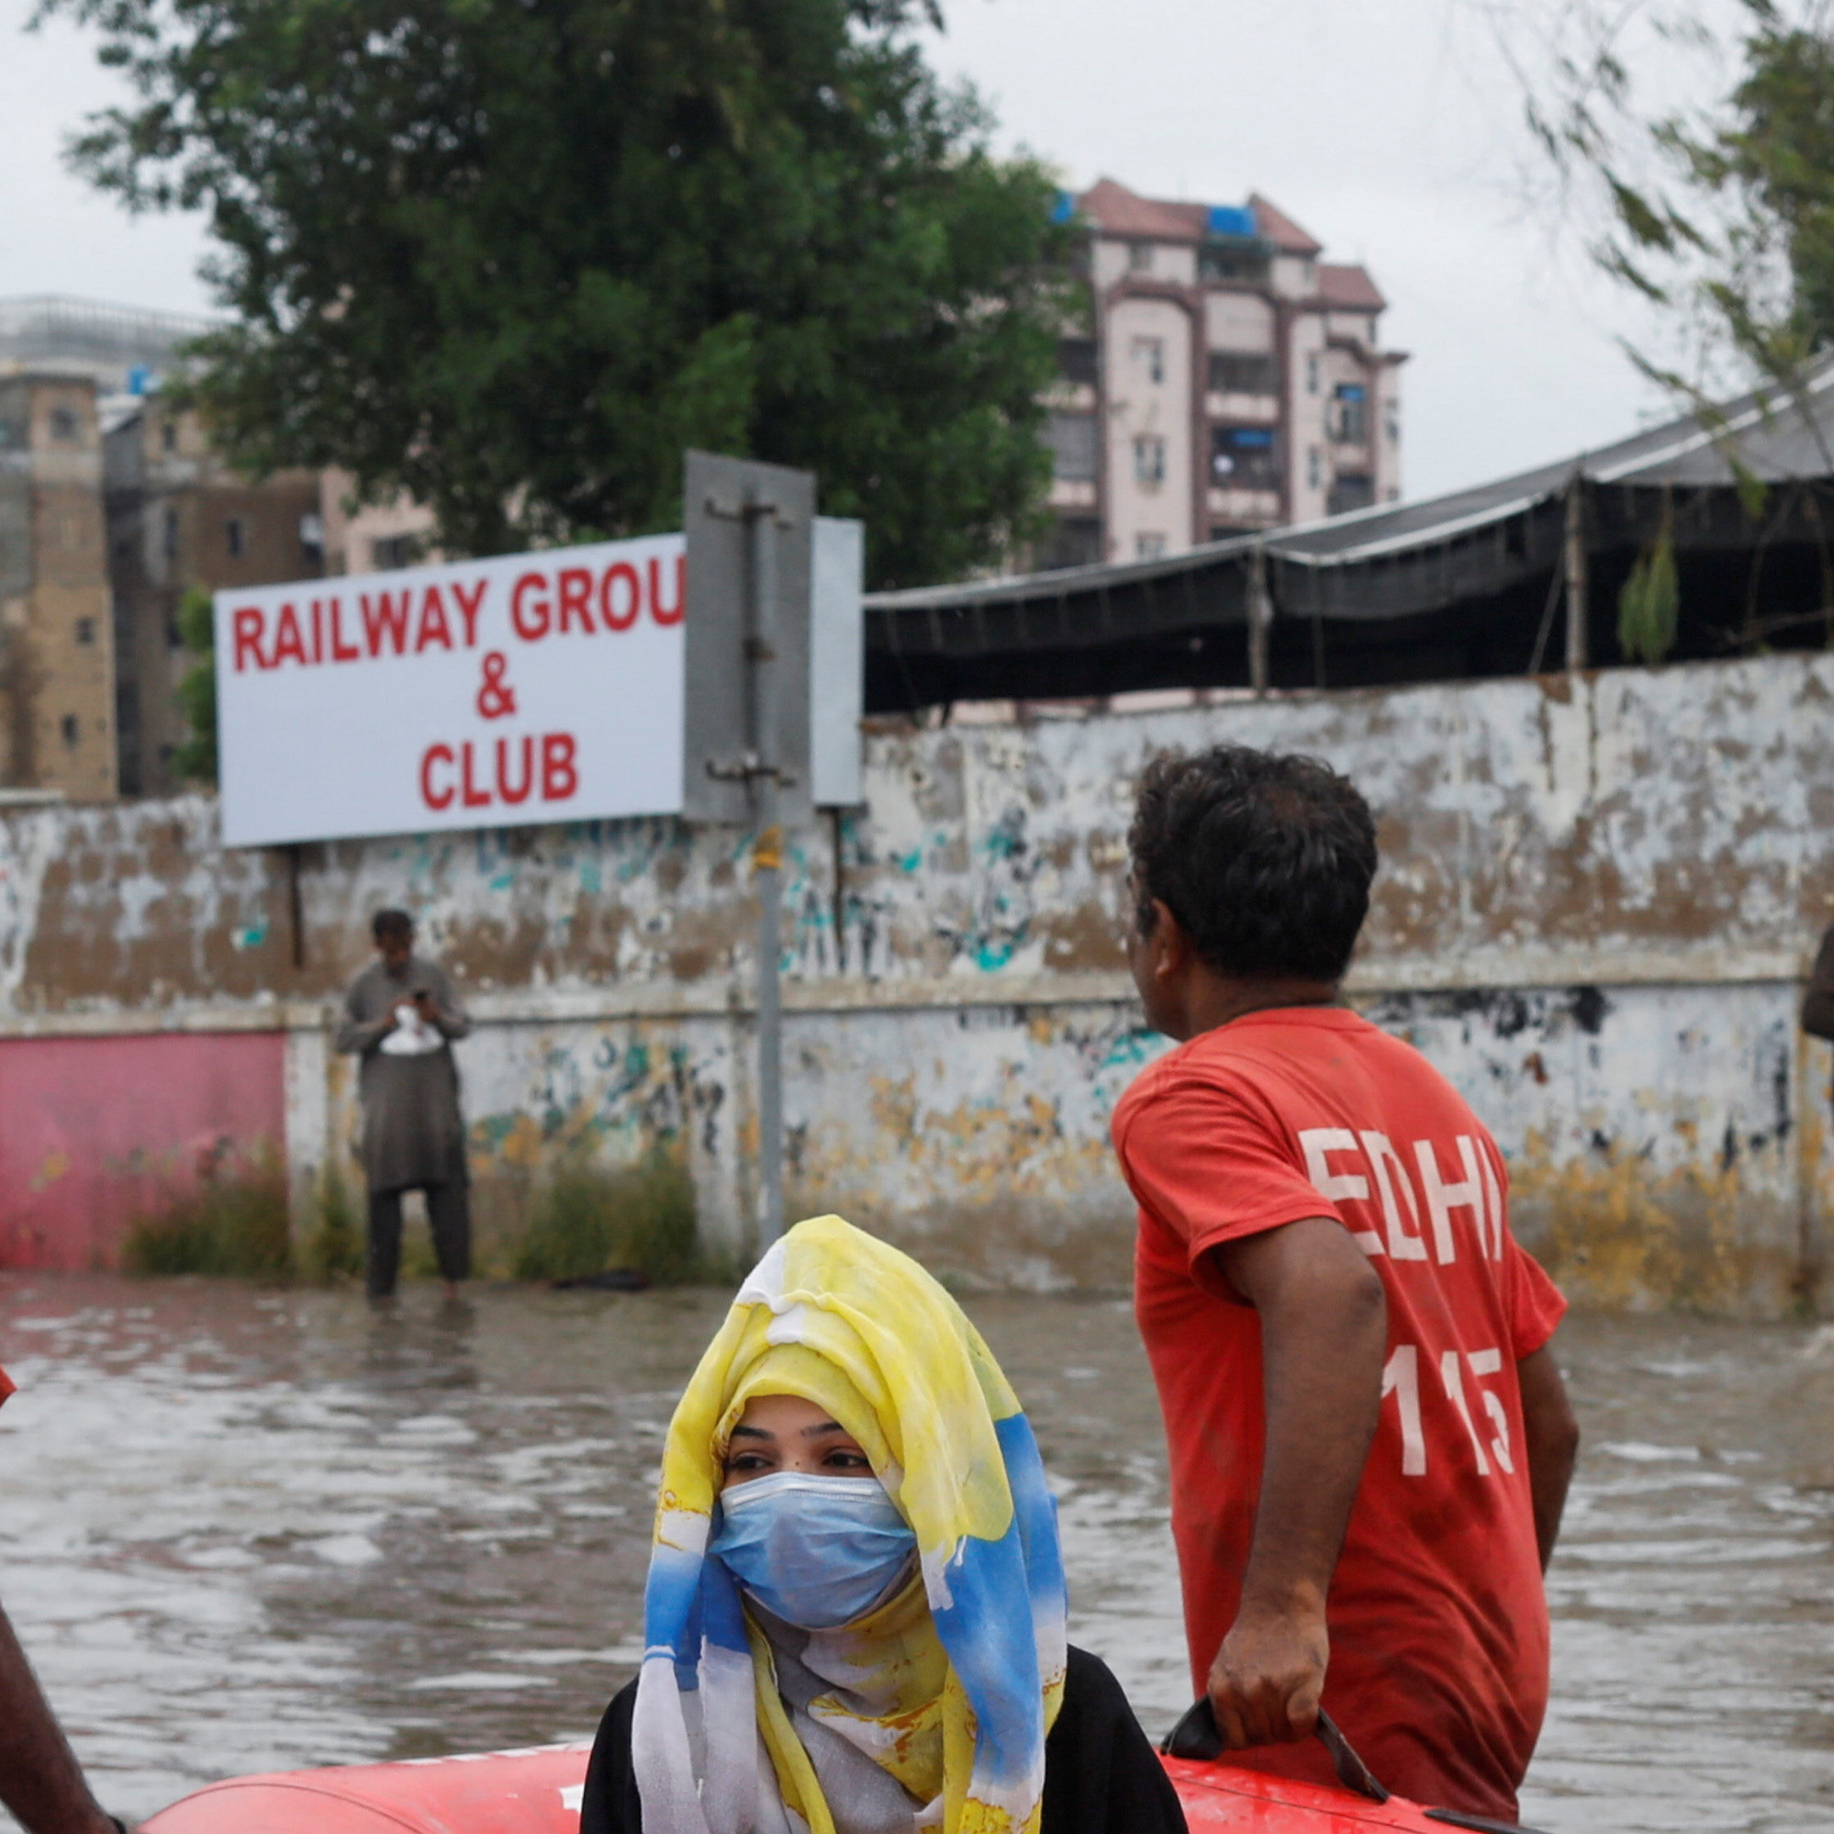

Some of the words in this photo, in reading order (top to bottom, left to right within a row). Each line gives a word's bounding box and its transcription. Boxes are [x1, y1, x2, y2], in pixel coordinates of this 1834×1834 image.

[232, 578, 489, 673] RAILWAY
[511, 553, 686, 642] GROU
[477, 651, 516, 720] &
[420, 733, 579, 810] CLUB
[1298, 1127, 1503, 1266] EDHI
[1381, 1345, 1514, 1476] 115
